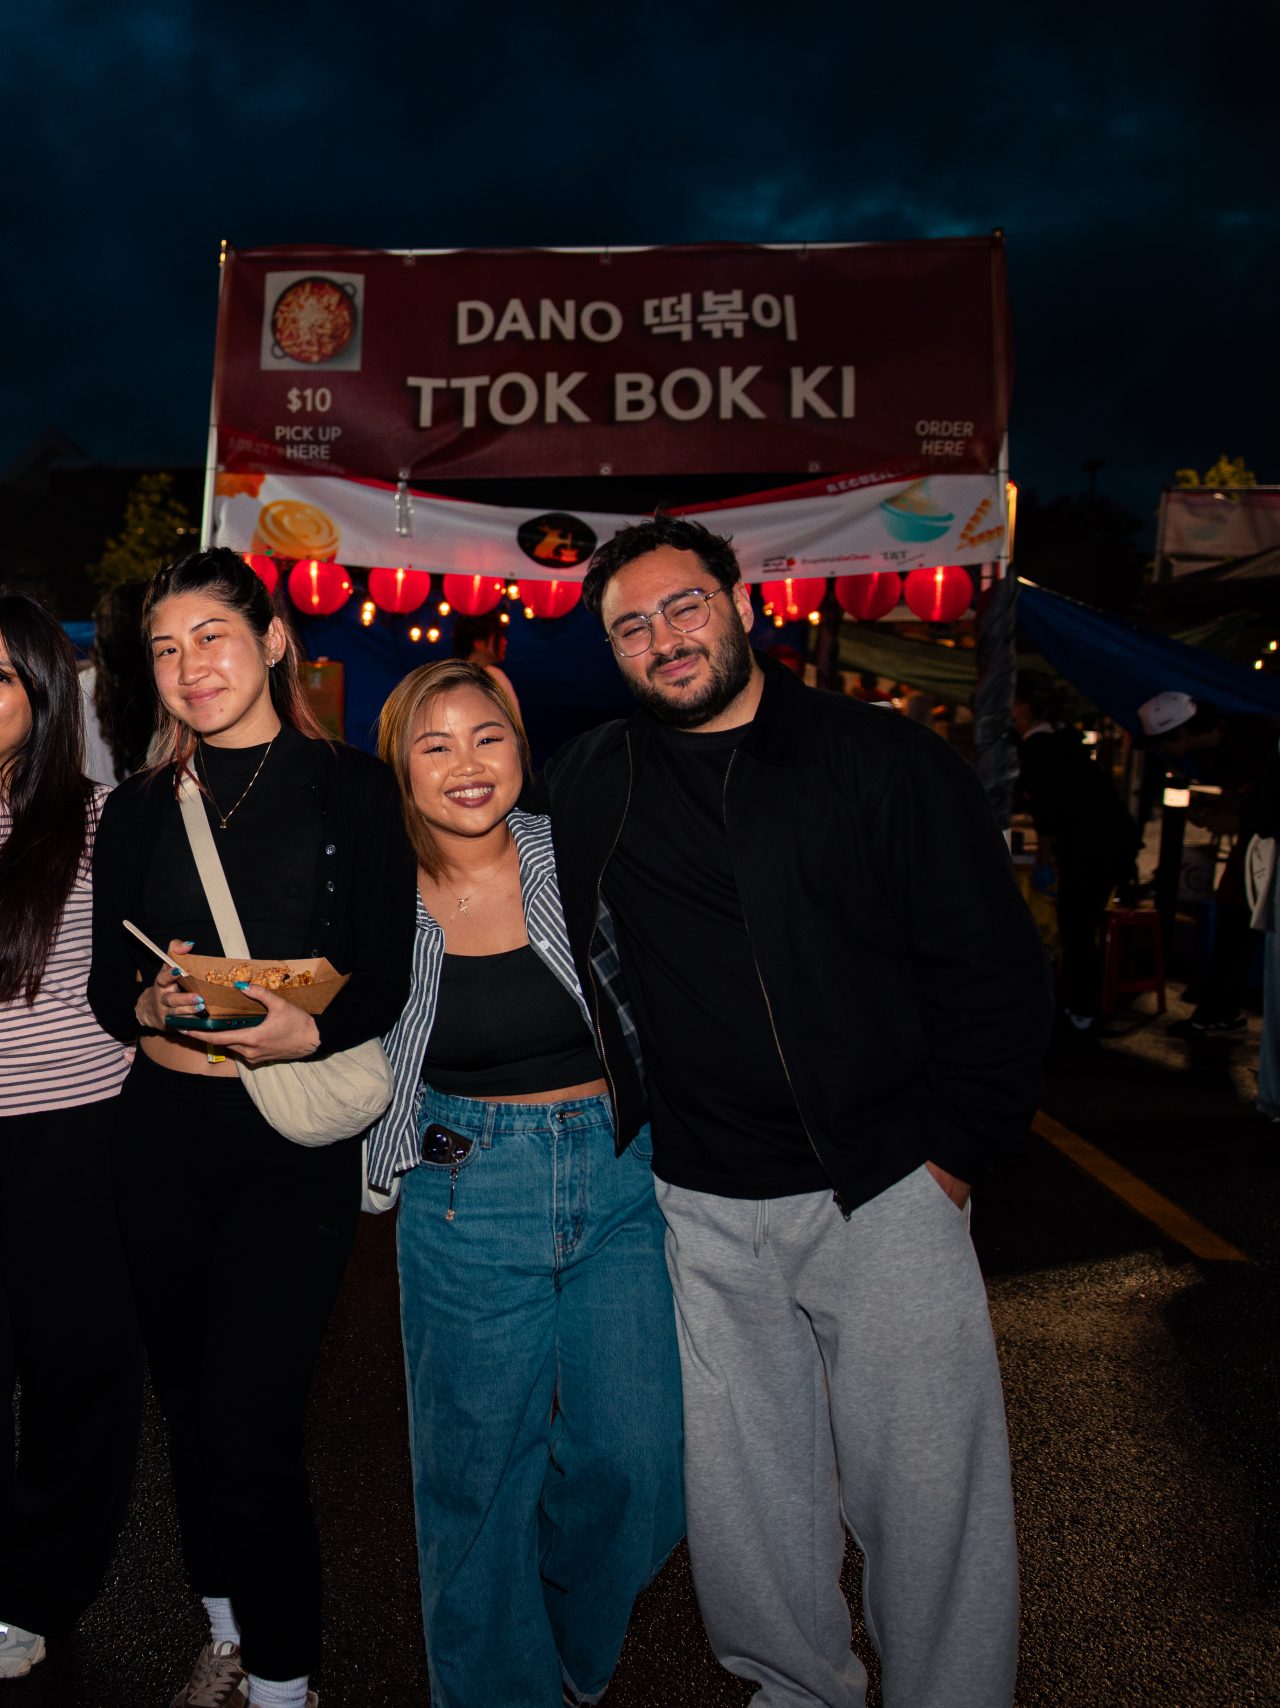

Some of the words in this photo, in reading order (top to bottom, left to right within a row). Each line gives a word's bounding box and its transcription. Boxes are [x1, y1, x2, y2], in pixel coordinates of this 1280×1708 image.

[457, 299, 623, 345] DANO
[643, 289, 798, 342] 떡볶이
[287, 385, 332, 416] $10
[406, 371, 591, 428] TTOK
[615, 366, 765, 422] BOK
[789, 365, 856, 420] KI
[275, 425, 314, 442] PICK
[318, 426, 342, 442] UP
[916, 420, 975, 437] ORDER
[286, 444, 331, 460] HERE
[921, 439, 966, 456] HERE
